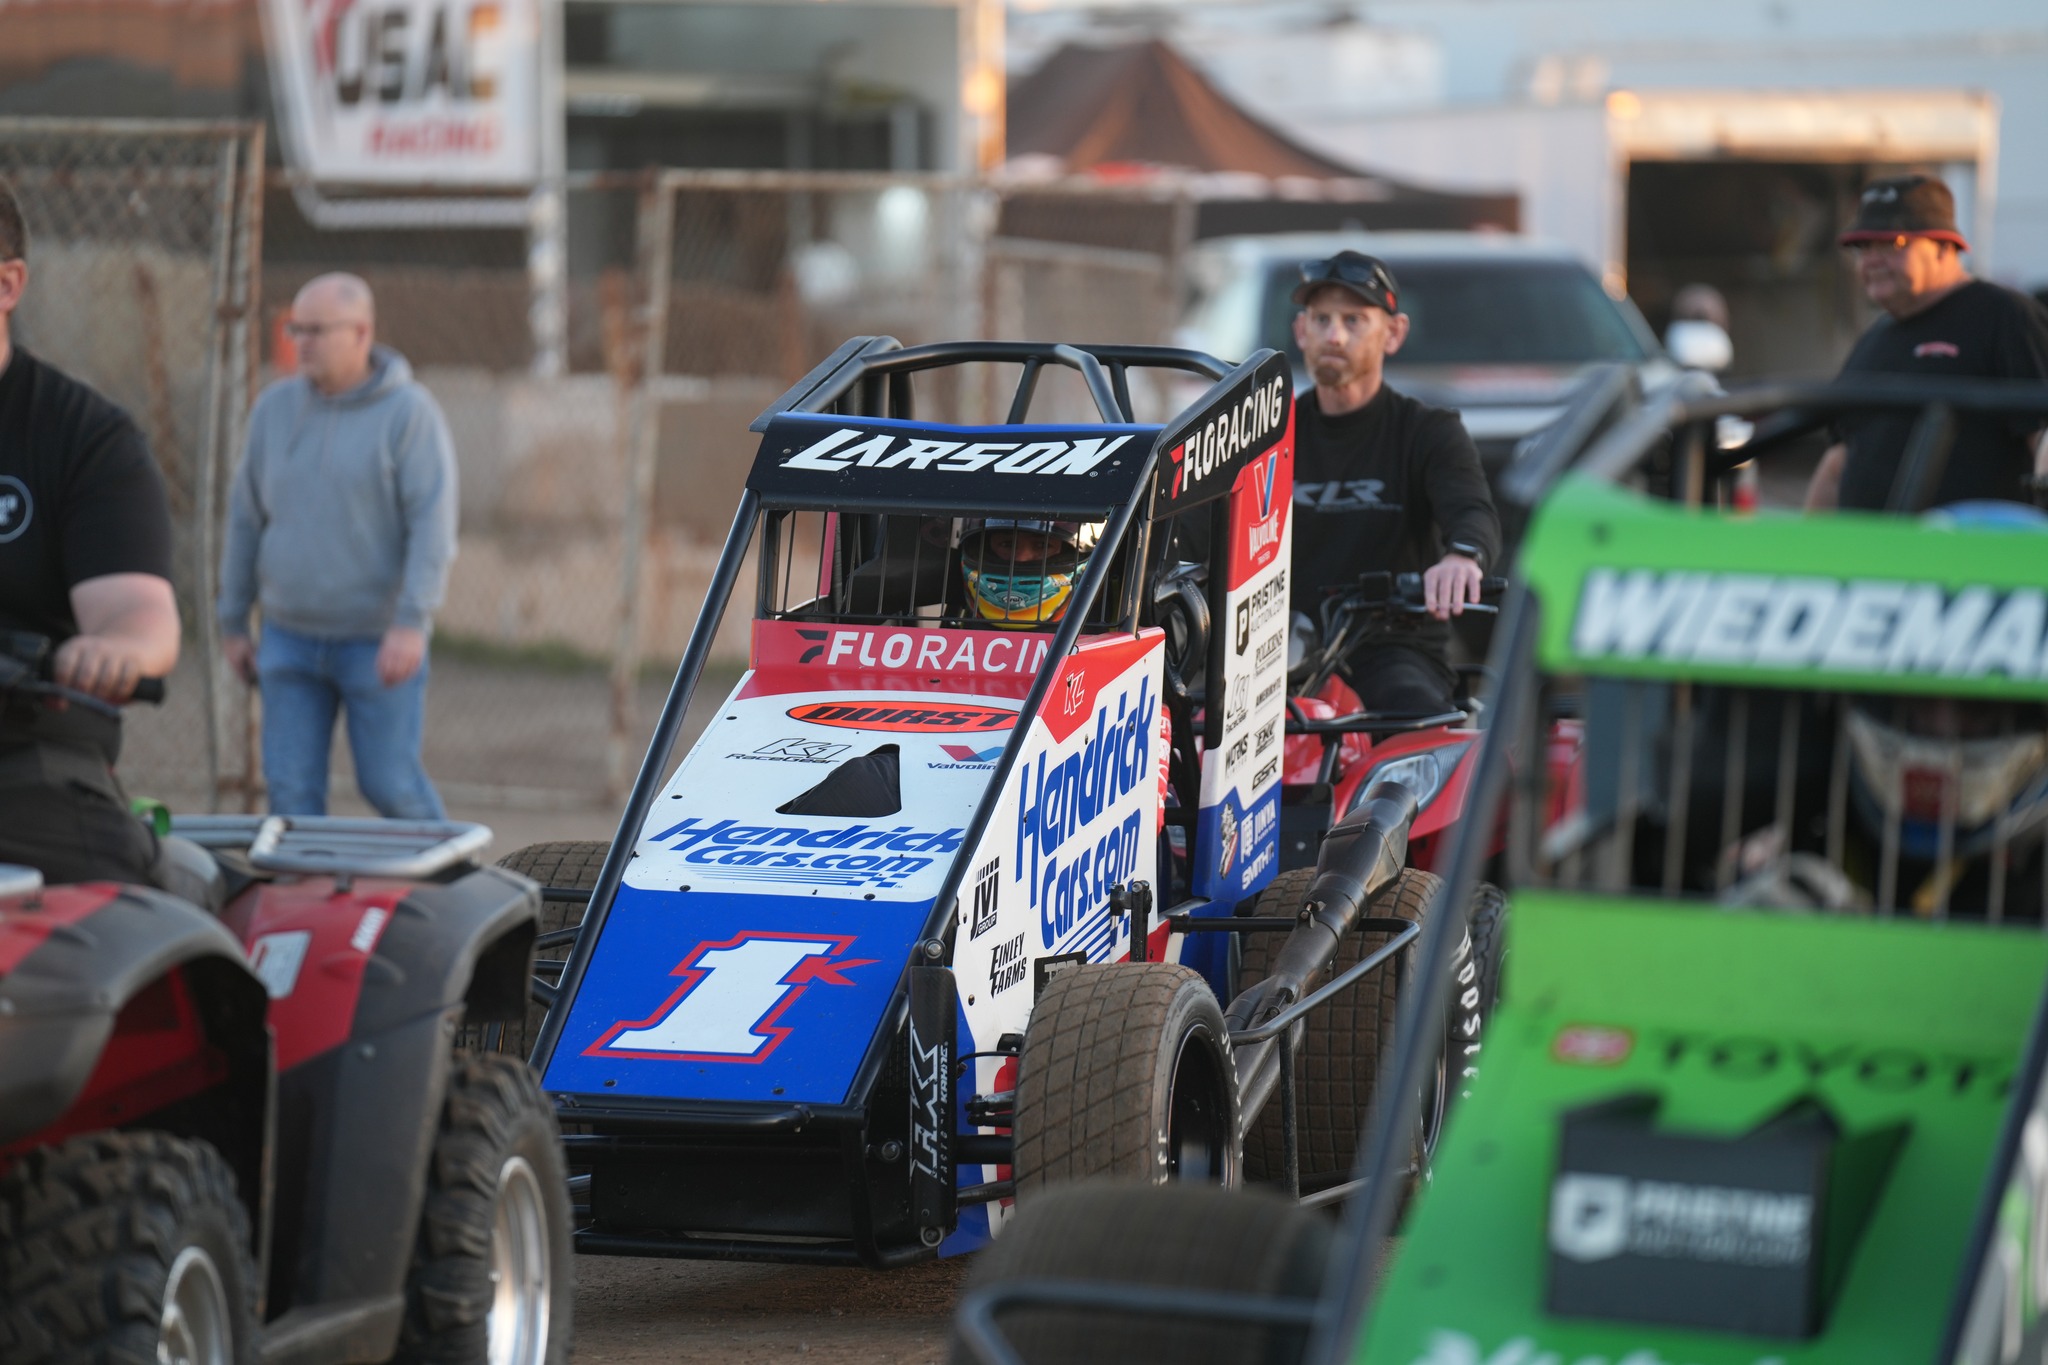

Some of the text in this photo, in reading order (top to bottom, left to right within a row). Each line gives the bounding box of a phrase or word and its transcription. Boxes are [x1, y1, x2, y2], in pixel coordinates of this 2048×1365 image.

[779, 428, 1135, 475] LARSON
[1182, 375, 1284, 492] FLORACING
[1251, 569, 1285, 616] PRISTINE
[1573, 568, 2048, 684] WIEDEMA
[799, 705, 1019, 727] DURST
[1015, 674, 1156, 910] Hendrick
[648, 818, 965, 852] Hendrick
[685, 846, 934, 873] Cars.com
[1041, 808, 1141, 950] Cars.com
[978, 914, 997, 935] GROUP
[989, 931, 1025, 980] FINLEY
[991, 956, 1027, 999] FARMS
